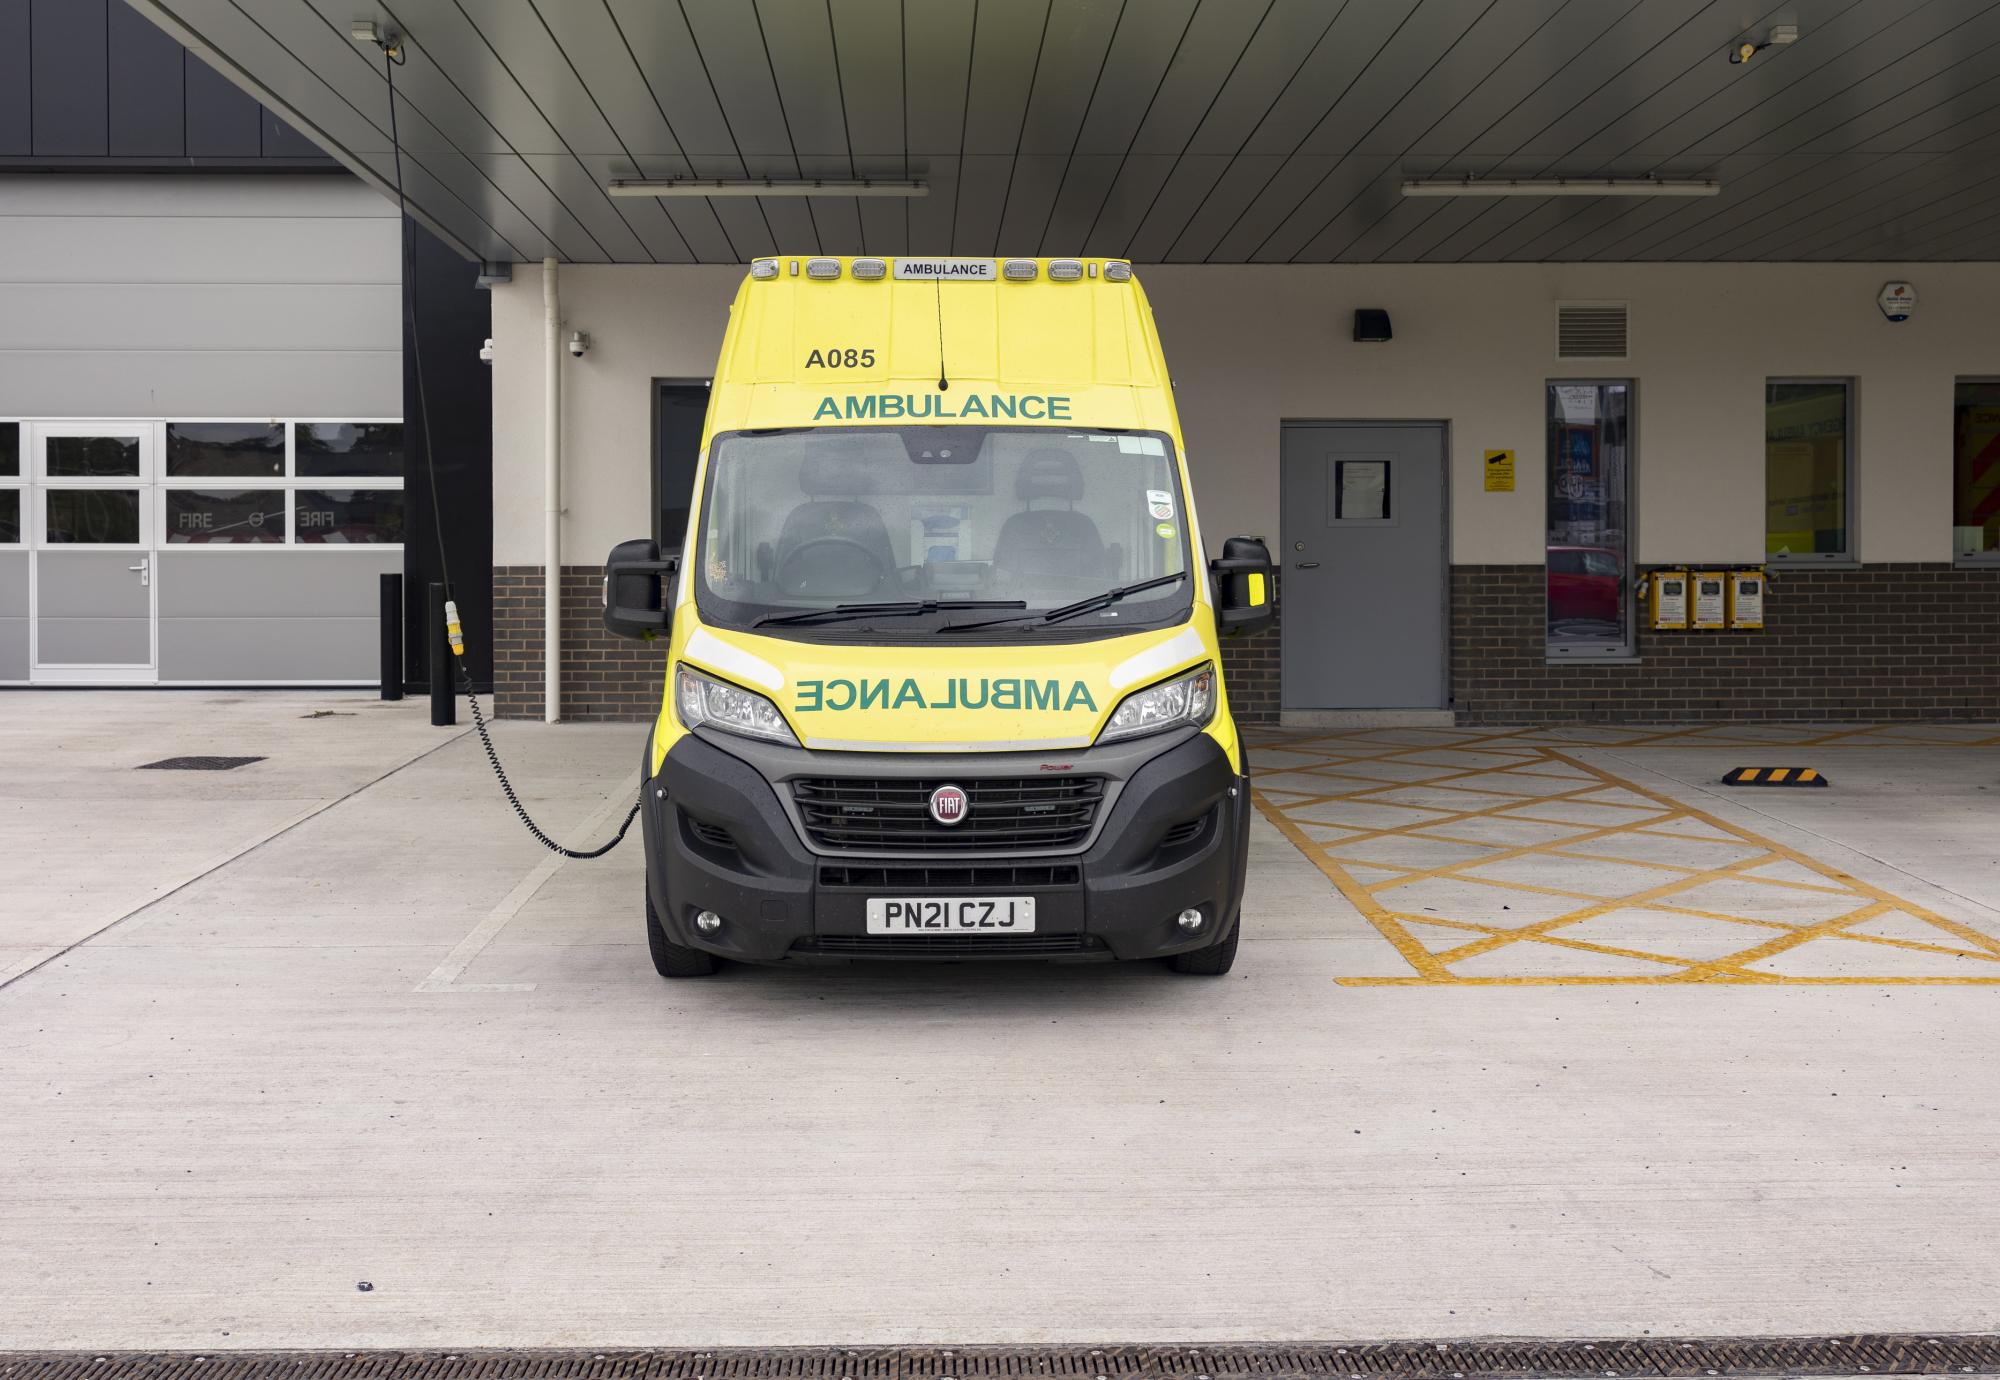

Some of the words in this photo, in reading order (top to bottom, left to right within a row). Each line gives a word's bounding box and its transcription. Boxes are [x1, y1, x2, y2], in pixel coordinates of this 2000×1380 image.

[903, 263, 988, 275] AMBULANCE
[805, 349, 876, 369] A085
[813, 394, 1072, 421] AMBULANCE
[178, 512, 213, 528] FIRE
[1039, 763, 1074, 772] Power
[938, 796, 960, 815] FIAT
[885, 902, 950, 928] PN21
[959, 901, 1016, 928] CZJ
